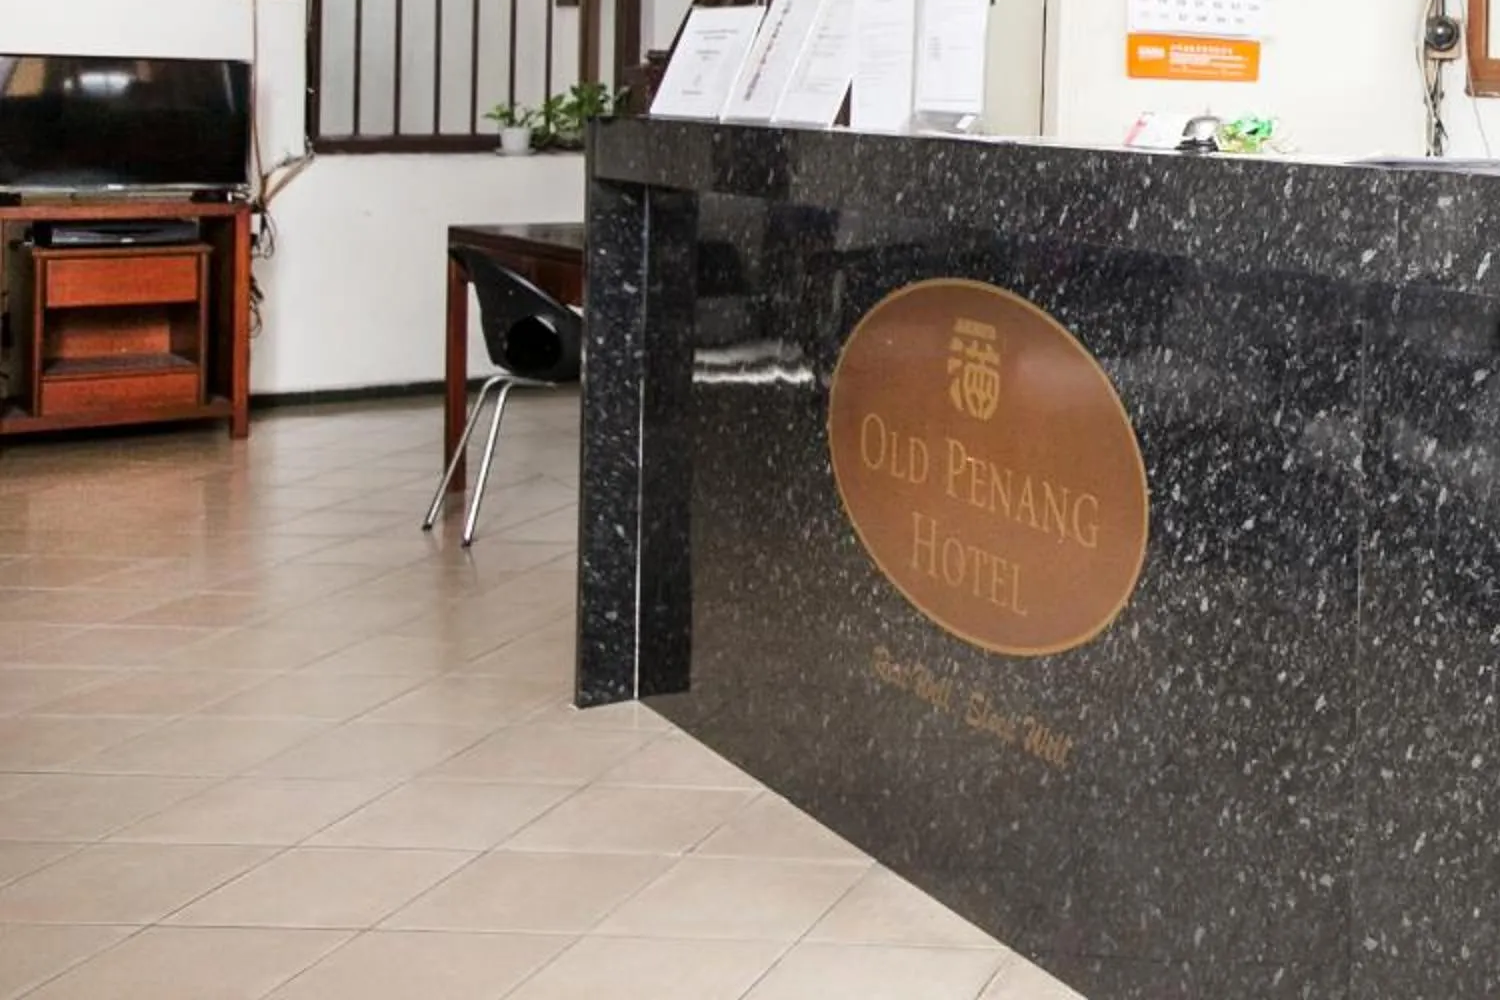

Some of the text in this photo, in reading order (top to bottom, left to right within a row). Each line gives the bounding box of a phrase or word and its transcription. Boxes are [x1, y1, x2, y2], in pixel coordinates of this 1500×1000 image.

[861, 413, 1099, 548] OLD PENANG
[912, 512, 1028, 617] HOTEL
